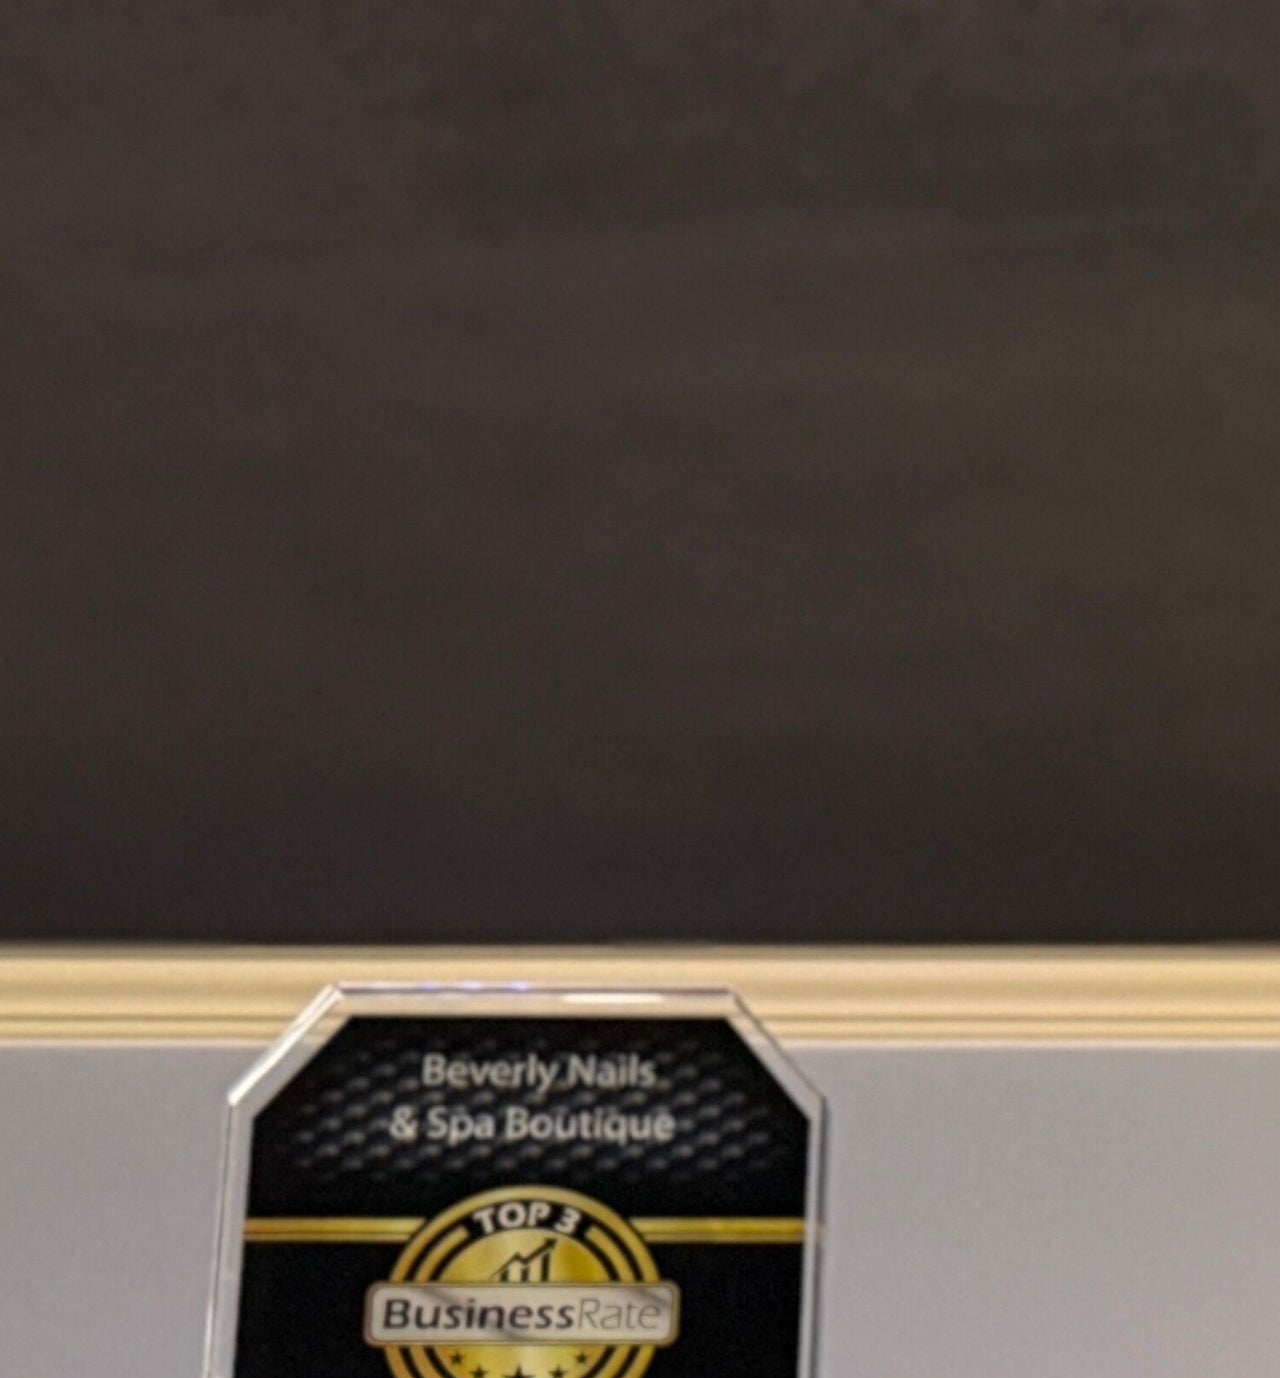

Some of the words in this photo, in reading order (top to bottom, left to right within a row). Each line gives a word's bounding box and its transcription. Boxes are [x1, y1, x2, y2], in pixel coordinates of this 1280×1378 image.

[422, 1053, 558, 1094] Beverly
[566, 1053, 657, 1088] Nails
[388, 1105, 418, 1141] &
[427, 1105, 495, 1145] Spa
[505, 1105, 677, 1145] Boutique
[473, 1201, 551, 1235] TOP
[555, 1206, 582, 1235] 3
[383, 1297, 663, 1331] BusinessRate
